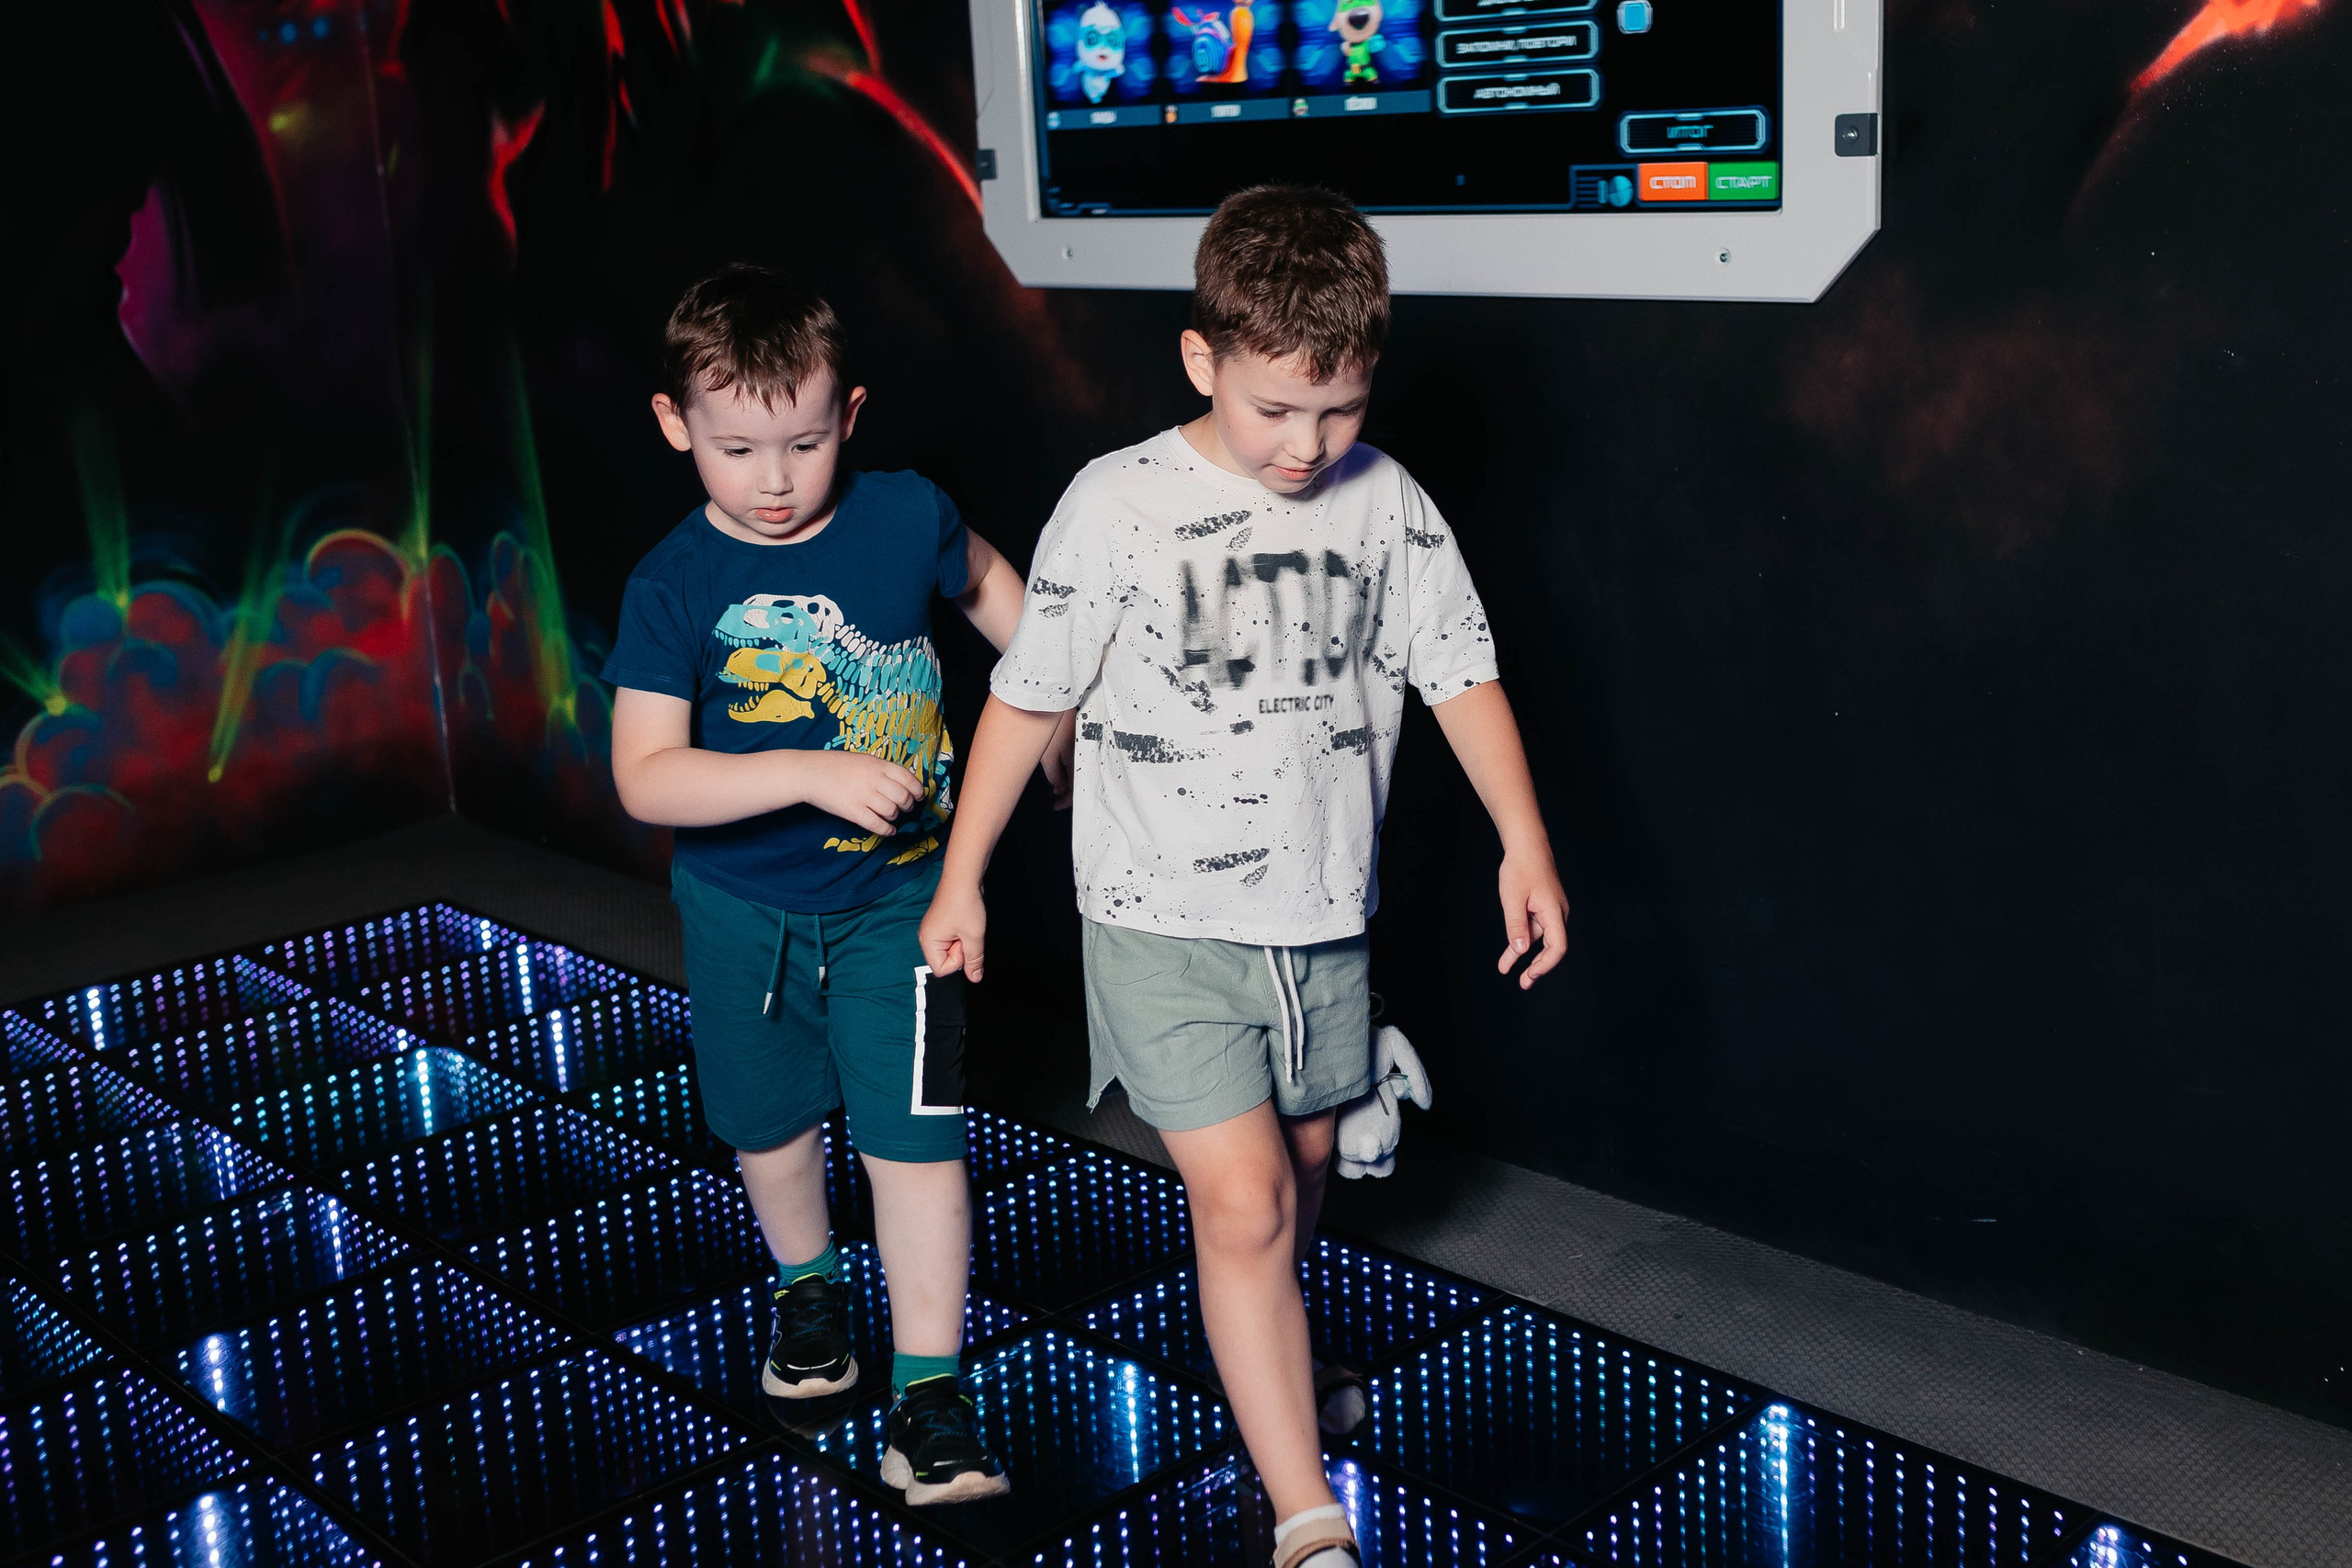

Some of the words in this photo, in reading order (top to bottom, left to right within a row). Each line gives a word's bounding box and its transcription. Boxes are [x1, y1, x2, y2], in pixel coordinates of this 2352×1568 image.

[1649, 175, 1697, 189] СТОП
[1715, 175, 1773, 189] СТАРТ
[1259, 695, 1311, 714] ELECTRIC
[1314, 694, 1334, 710] CITY
